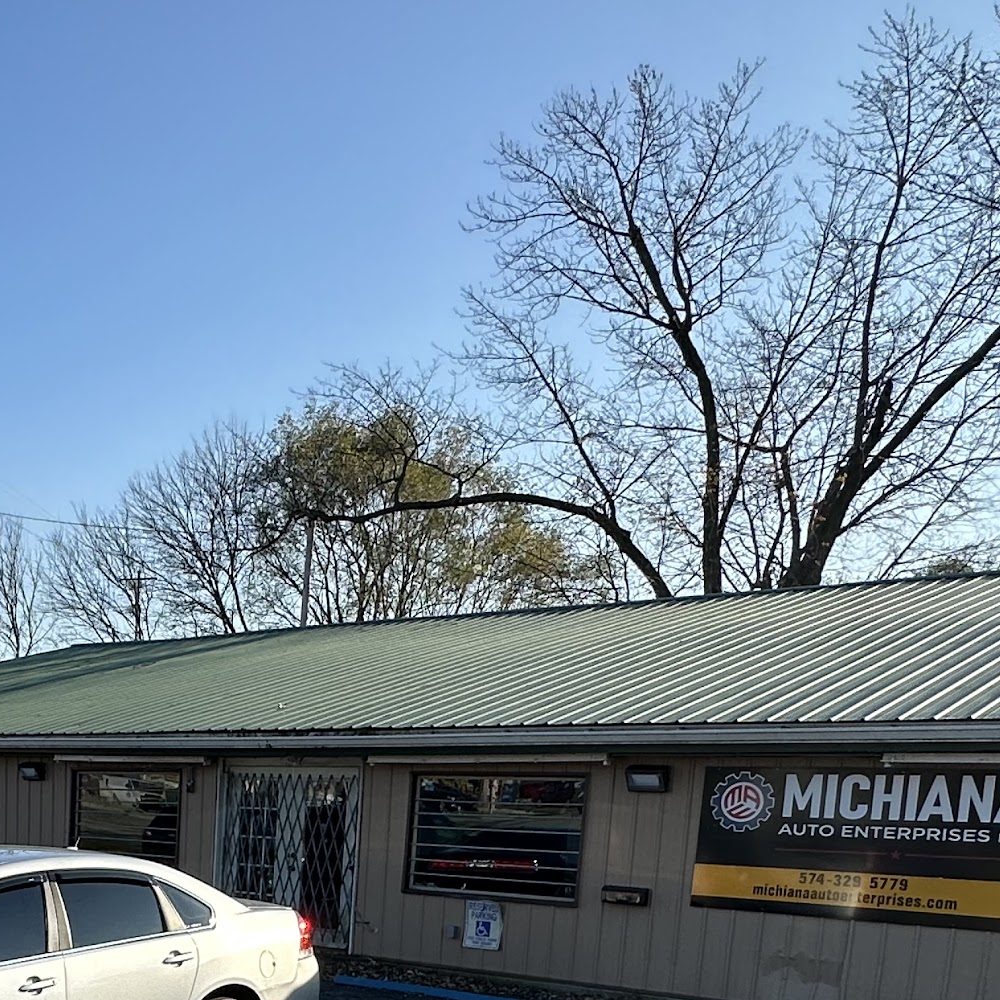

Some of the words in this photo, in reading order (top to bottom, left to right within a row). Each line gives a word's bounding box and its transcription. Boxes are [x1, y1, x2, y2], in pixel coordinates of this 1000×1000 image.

[782, 773, 1000, 823] MICHIAN
[778, 823, 835, 837] AUTO
[841, 825, 991, 842] ENTERPRISES
[752, 884, 957, 911] michianaautoeterprises.com
